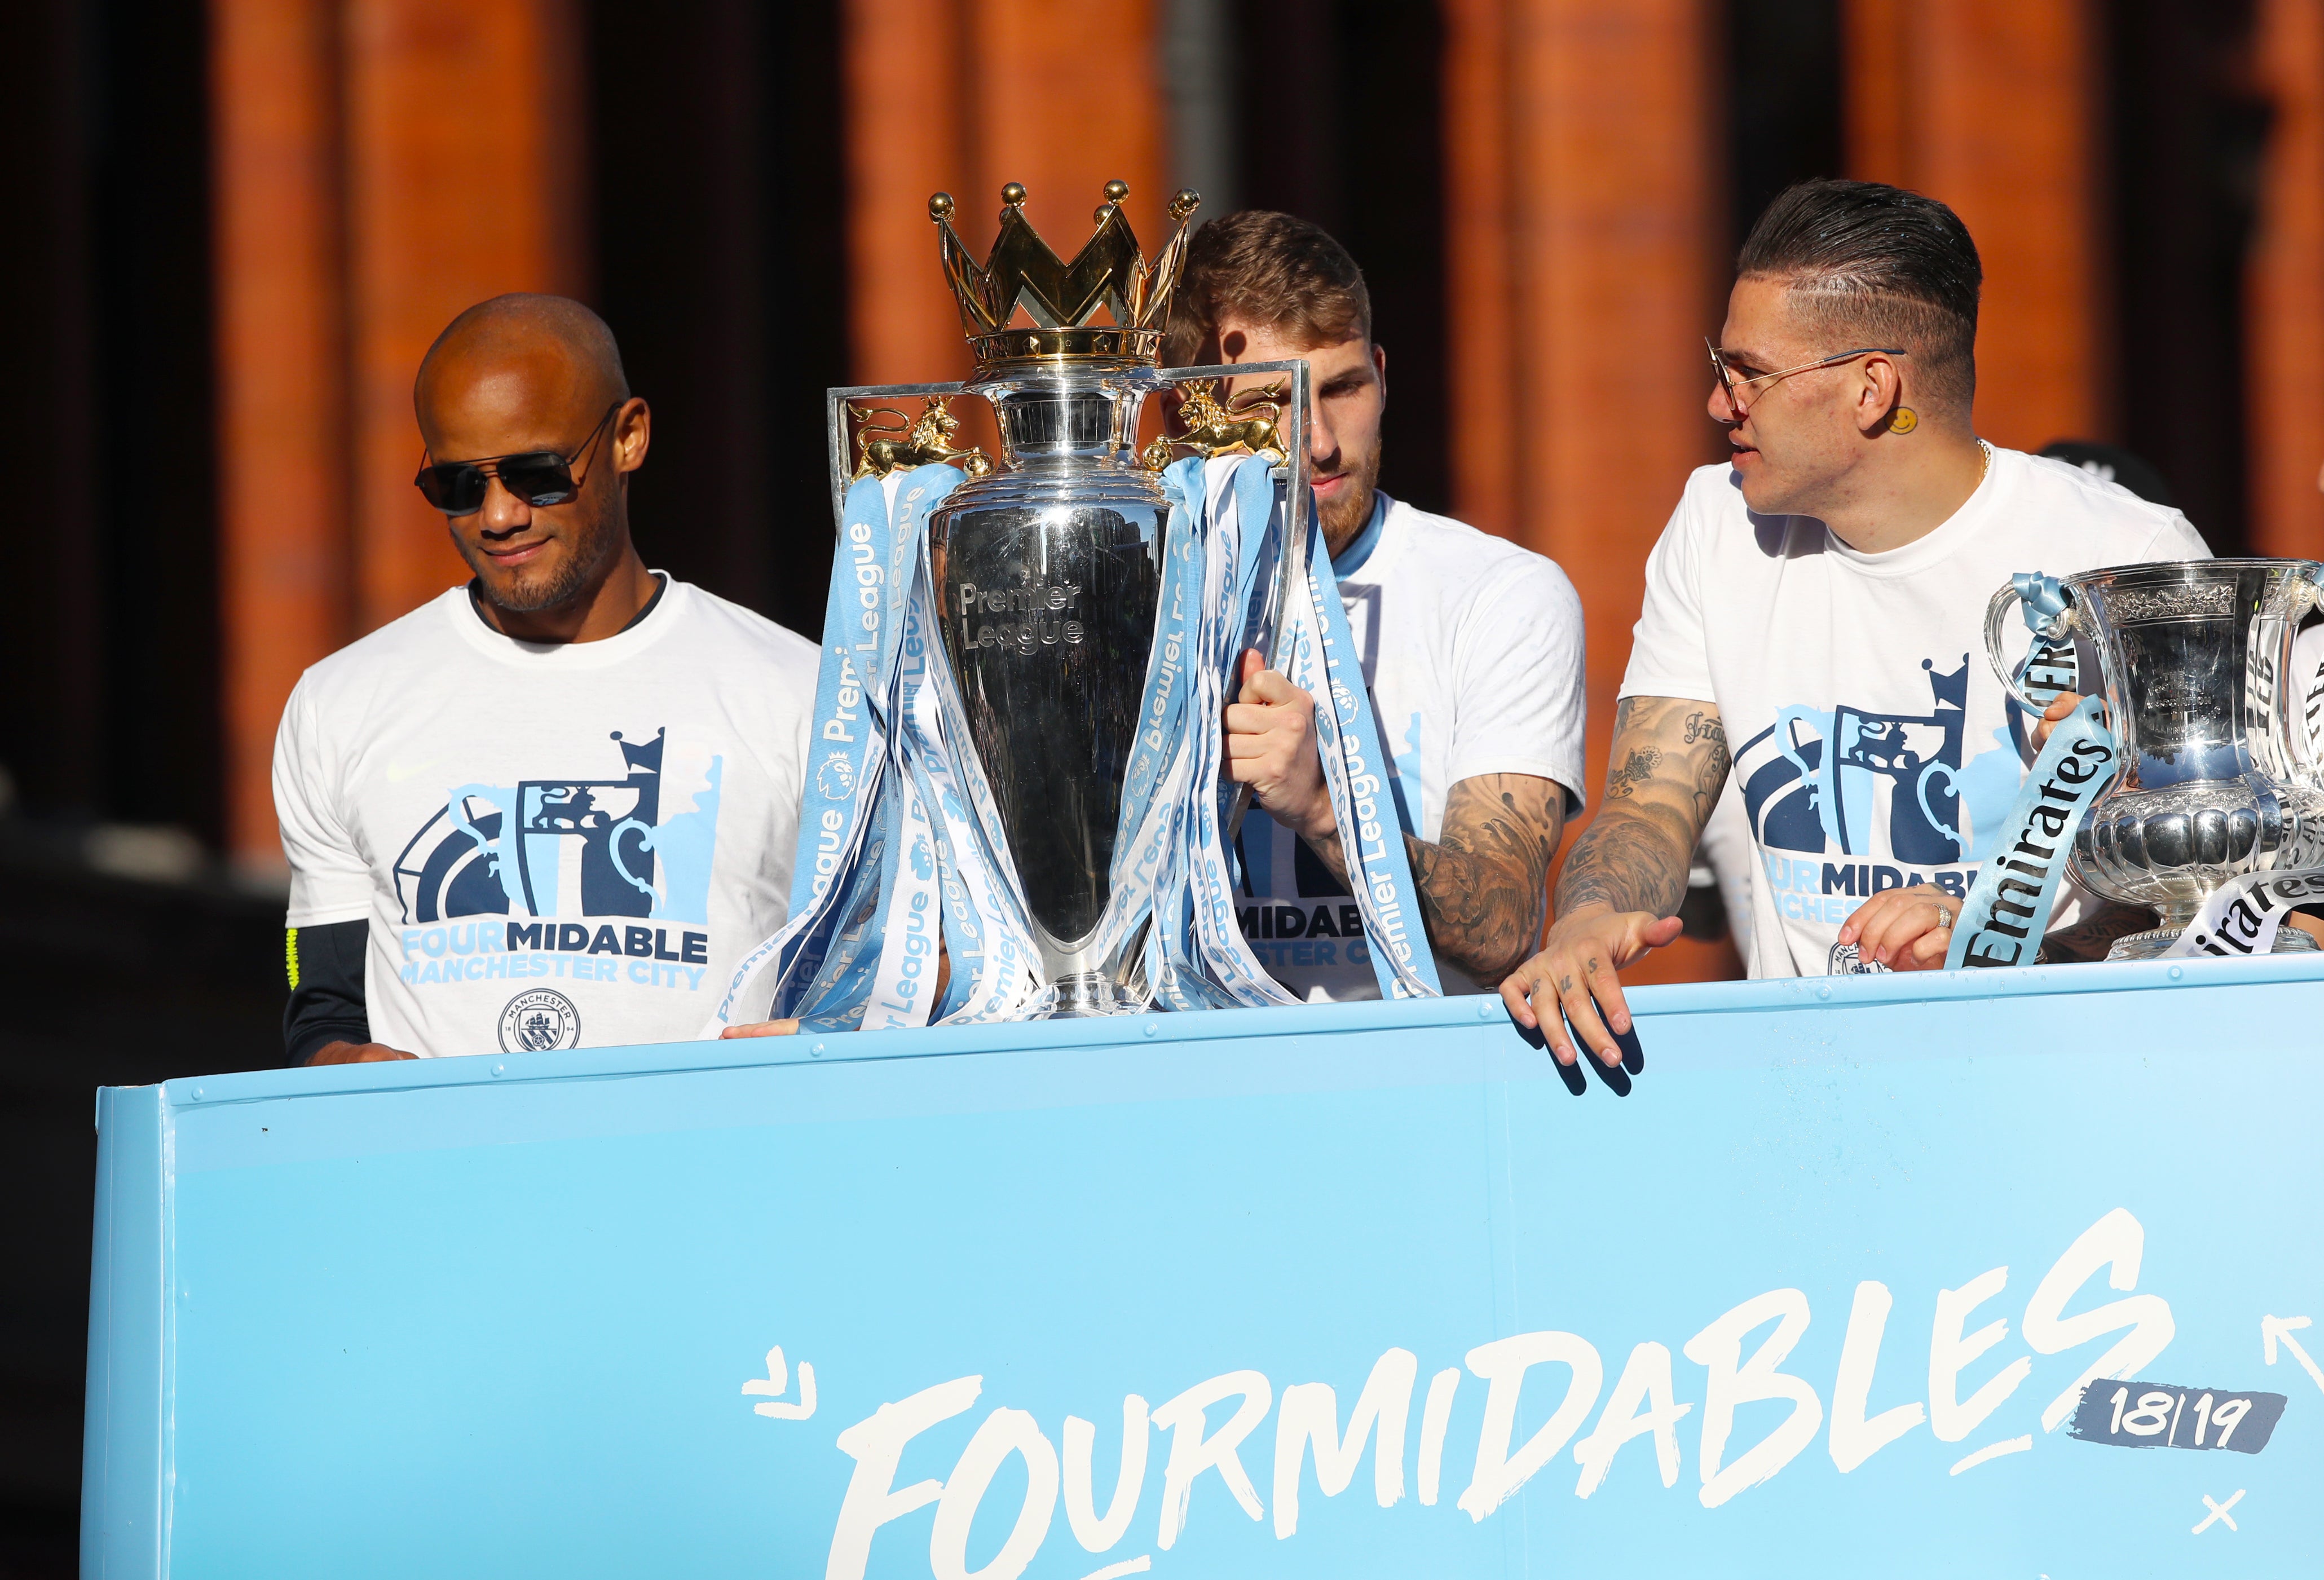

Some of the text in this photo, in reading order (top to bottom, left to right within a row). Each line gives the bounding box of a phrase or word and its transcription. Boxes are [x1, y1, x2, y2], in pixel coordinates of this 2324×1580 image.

[849, 523, 885, 652] League
[891, 487, 925, 610] League
[960, 579, 1082, 615] Premier
[962, 618, 1084, 655] League
[1343, 735, 1387, 863] League
[1961, 739, 2113, 968] Emirates
[402, 922, 708, 964] FOURMIDABLE
[881, 891, 932, 1014] League
[936, 839, 985, 959] League
[1370, 871, 1420, 999] Premier
[400, 953, 707, 991] MANCHESTER CITY
[509, 995, 571, 1019] MANCHESTER
[717, 920, 799, 1023] Premier
[950, 927, 1016, 1026] Premier
[825, 1207, 2176, 1580] FOURMIDABLES
